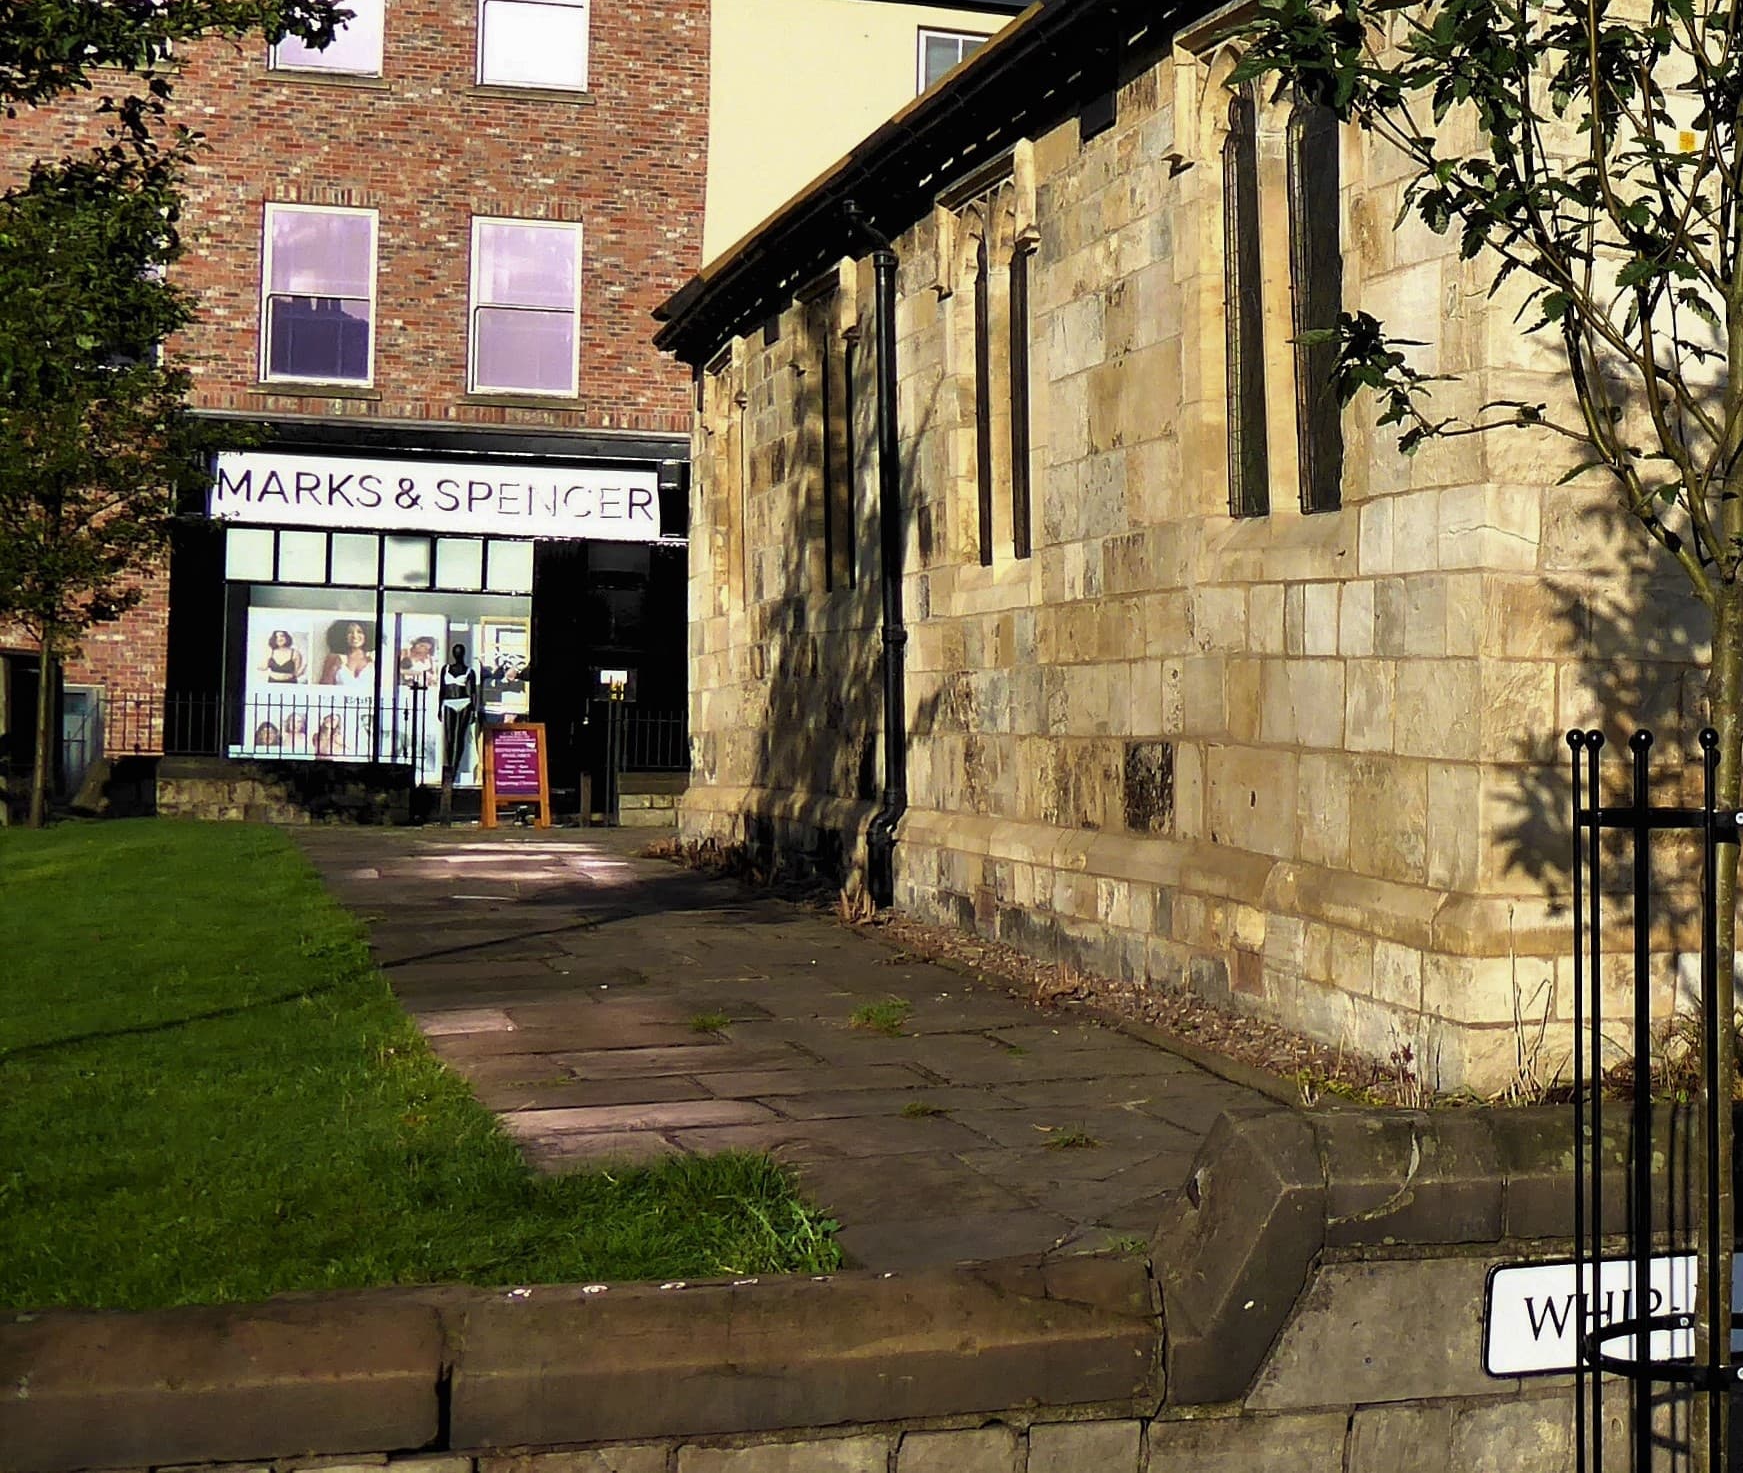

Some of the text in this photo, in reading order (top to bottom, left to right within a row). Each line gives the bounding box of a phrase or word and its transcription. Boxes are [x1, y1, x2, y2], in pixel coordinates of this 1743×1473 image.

[217, 466, 655, 522] MARKS & SPENCER
